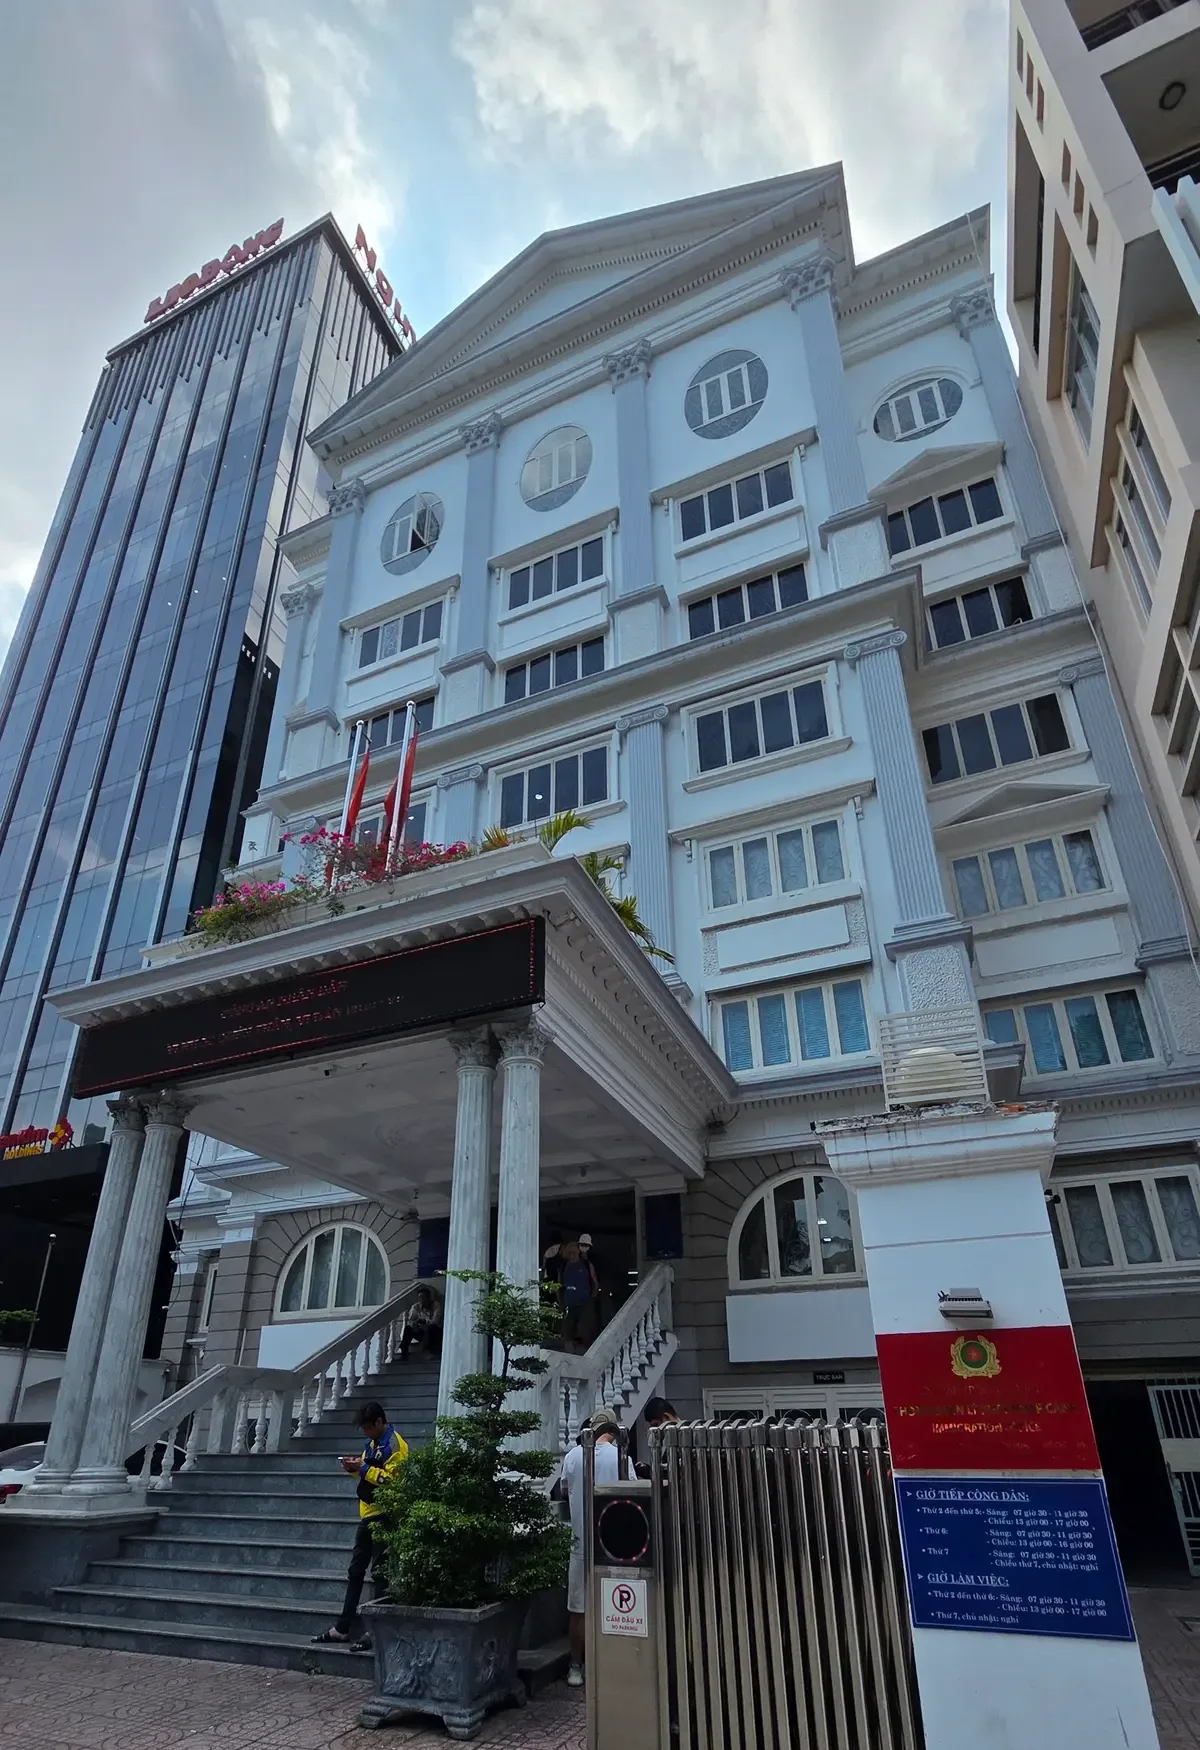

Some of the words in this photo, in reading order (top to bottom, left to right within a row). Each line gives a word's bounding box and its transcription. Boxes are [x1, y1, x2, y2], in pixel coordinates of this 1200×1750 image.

[916, 1488, 936, 1500] GIỜ
[938, 1488, 964, 1500] TIẾP
[967, 1489, 999, 1500] CÔNG
[1002, 1489, 1029, 1501] DÂN:
[922, 1506, 937, 1514] Thứ
[986, 1508, 1008, 1516] Sáng:
[1024, 1509, 1036, 1517] giờ
[1064, 1510, 1077, 1518] giờ
[990, 1529, 1012, 1537] Sáng:
[1028, 1530, 1040, 1538] giờ
[1029, 1540, 1041, 1548] giờ
[1070, 1541, 1082, 1549] giờ
[993, 1550, 1015, 1558] Sáng:
[1019, 1560, 1032, 1568] thứ
[1042, 1561, 1056, 1569] chủ
[1058, 1562, 1078, 1571] nhật:
[928, 1570, 948, 1582] GIỜ
[950, 1572, 975, 1584] LÀM
[977, 1574, 1009, 1586] VIỆC:
[933, 1590, 949, 1598] Thứ
[1000, 1594, 1022, 1602] Sáng:
[1039, 1596, 1052, 1604] giờ
[1081, 1599, 1094, 1607] giờ
[1041, 1606, 1054, 1614] giờ
[1082, 1608, 1095, 1616] giờ
[953, 1612, 960, 1620] 7,
[979, 1614, 999, 1623] nhật:
